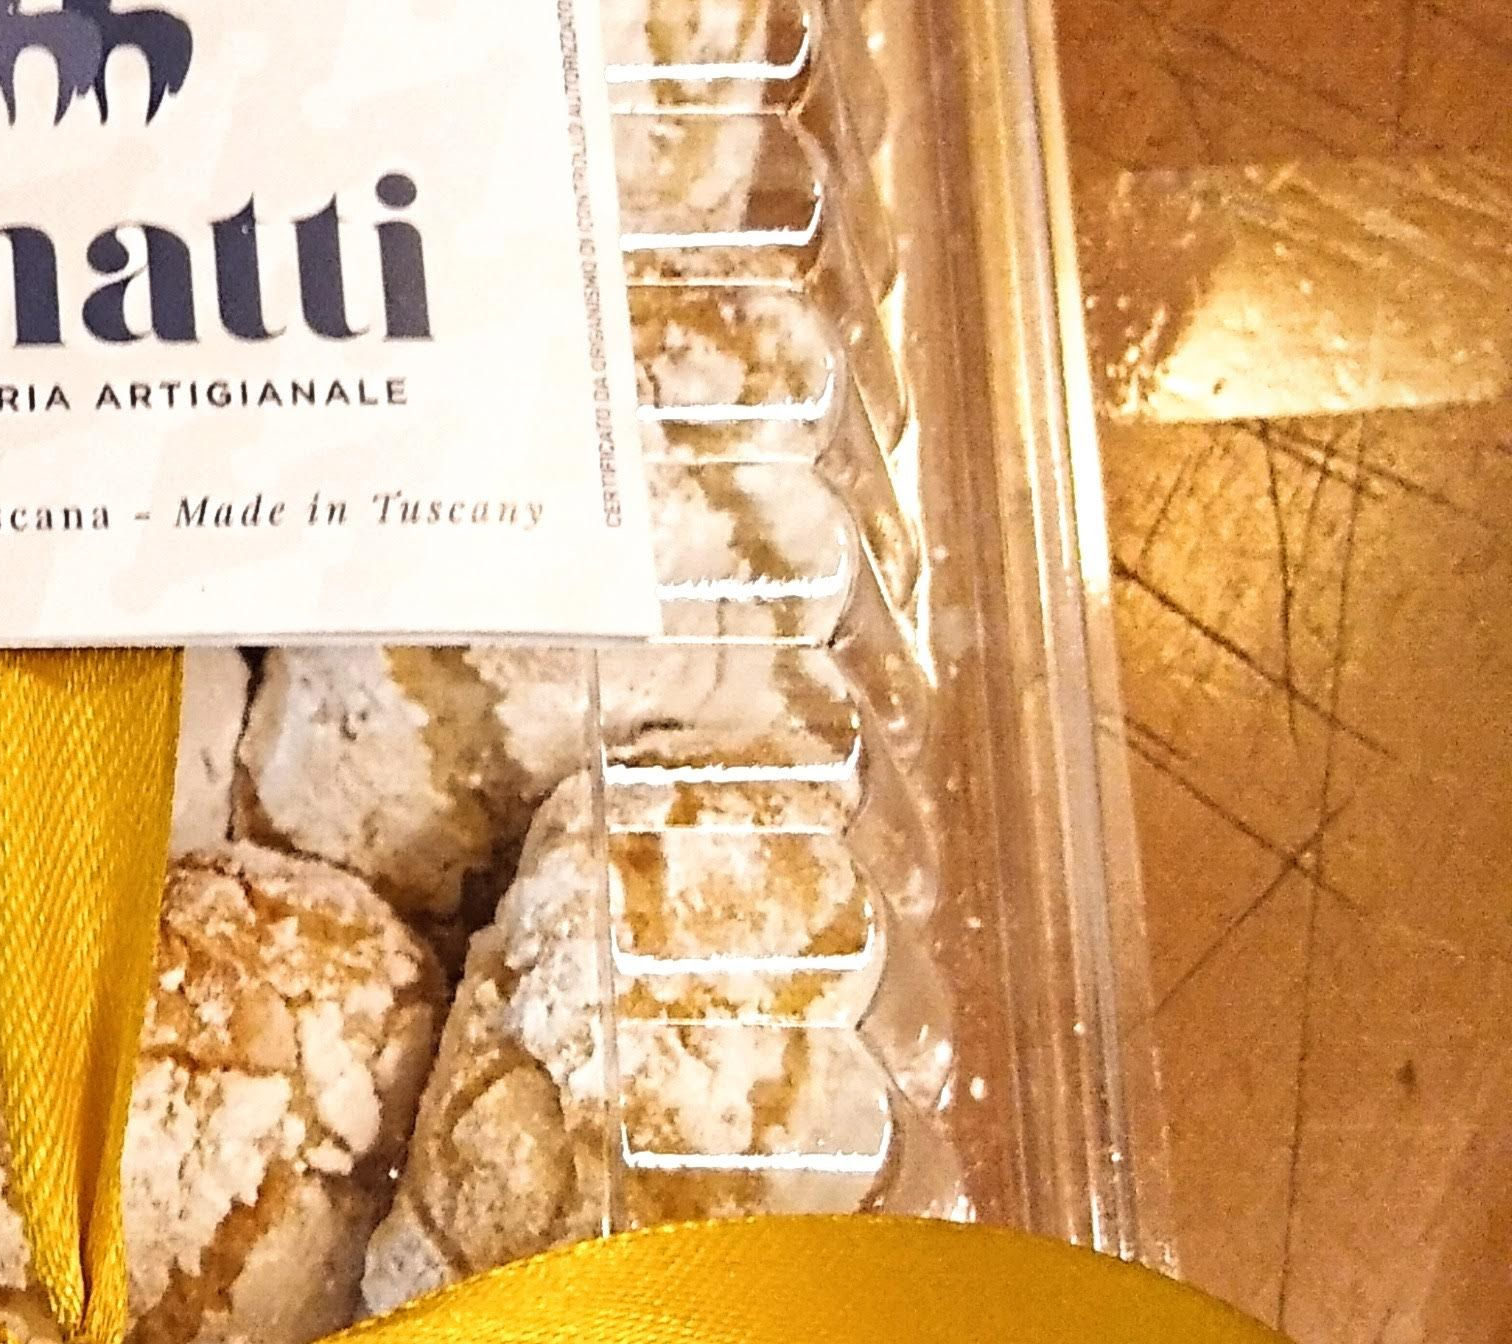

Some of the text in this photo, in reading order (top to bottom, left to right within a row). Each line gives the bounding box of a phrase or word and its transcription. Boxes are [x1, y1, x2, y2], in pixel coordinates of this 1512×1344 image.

[95, 379, 406, 410] ARTIGIANALE
[175, 493, 285, 528] Made
[308, 493, 347, 525] in
[372, 489, 545, 532] Tuscany
